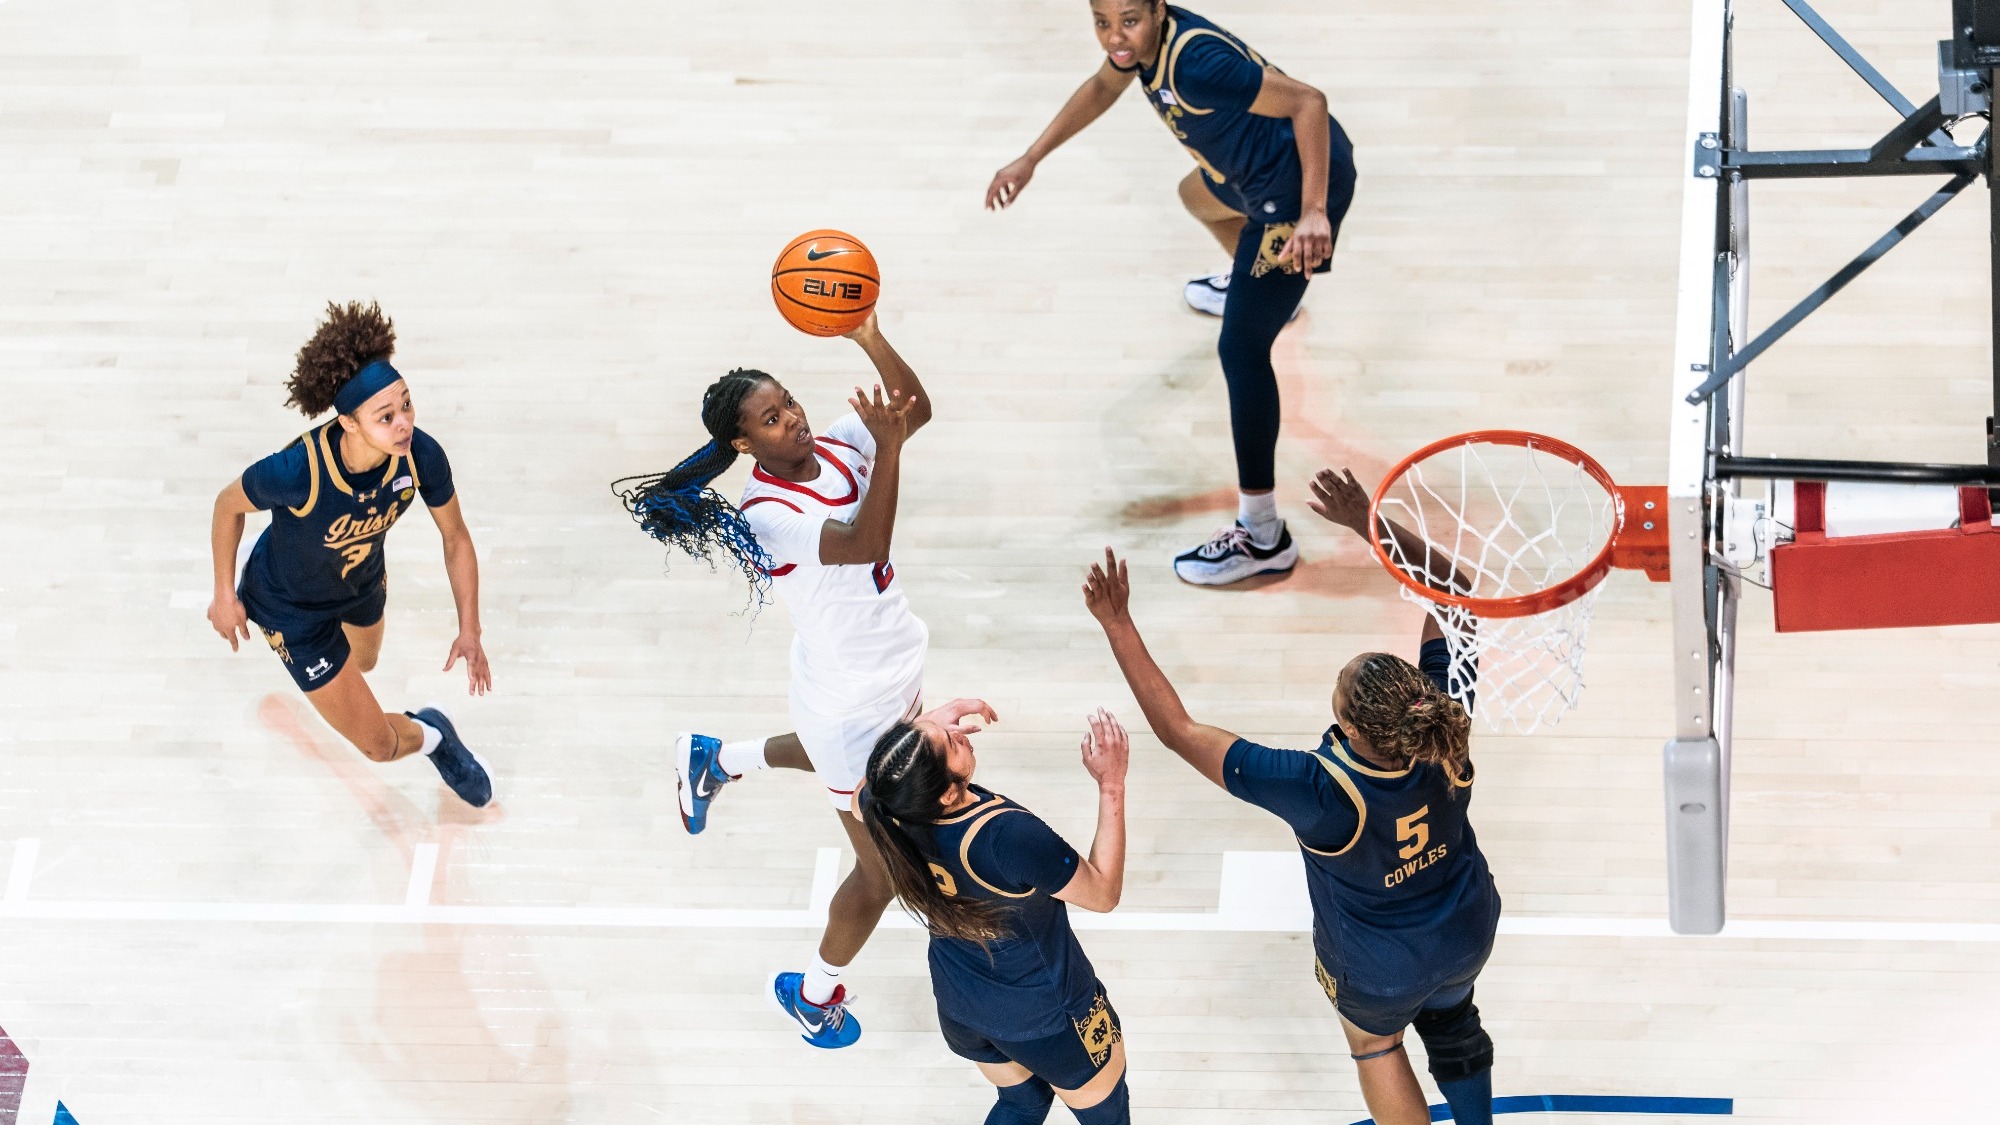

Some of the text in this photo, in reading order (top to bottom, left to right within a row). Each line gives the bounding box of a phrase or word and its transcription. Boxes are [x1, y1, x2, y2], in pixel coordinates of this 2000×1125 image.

[803, 277, 863, 300] ELITE
[324, 501, 399, 545] Irish
[341, 542, 373, 580] 3
[1396, 804, 1429, 860] 5
[1384, 843, 1448, 888] COWLES
